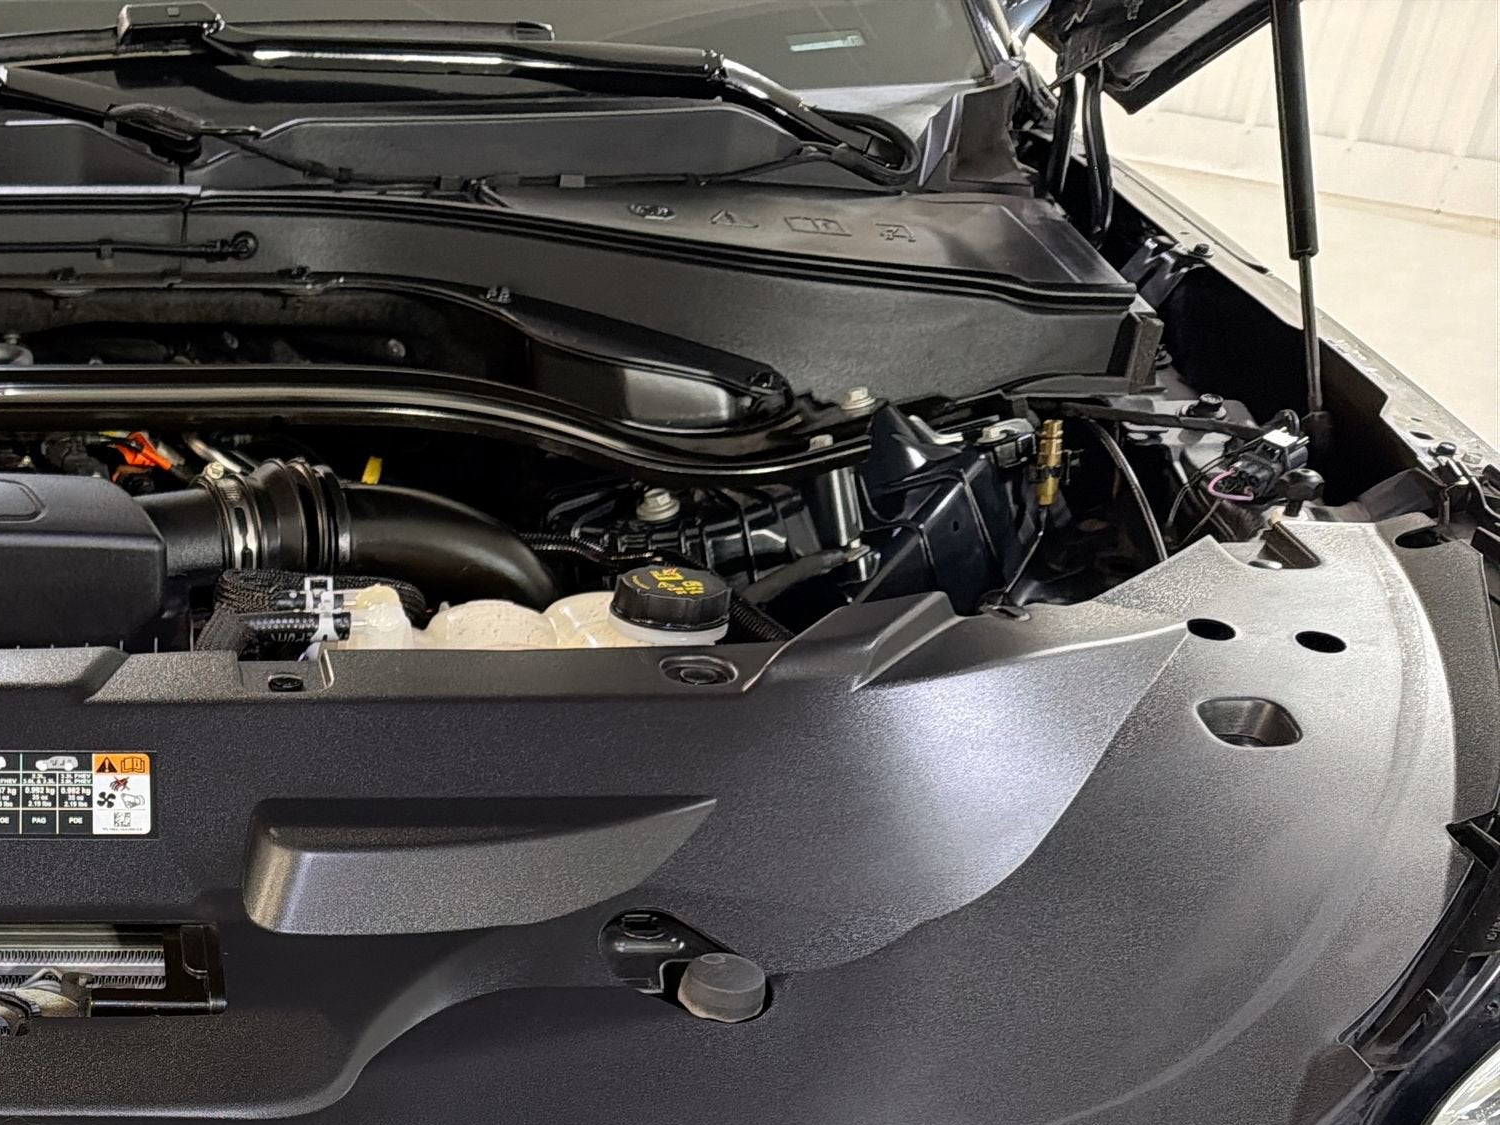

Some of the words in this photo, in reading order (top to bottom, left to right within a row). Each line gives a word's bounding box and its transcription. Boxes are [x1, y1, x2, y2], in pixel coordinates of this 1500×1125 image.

[7, 787, 16, 796] kg
[46, 787, 55, 796] kg
[81, 787, 91, 796] kg
